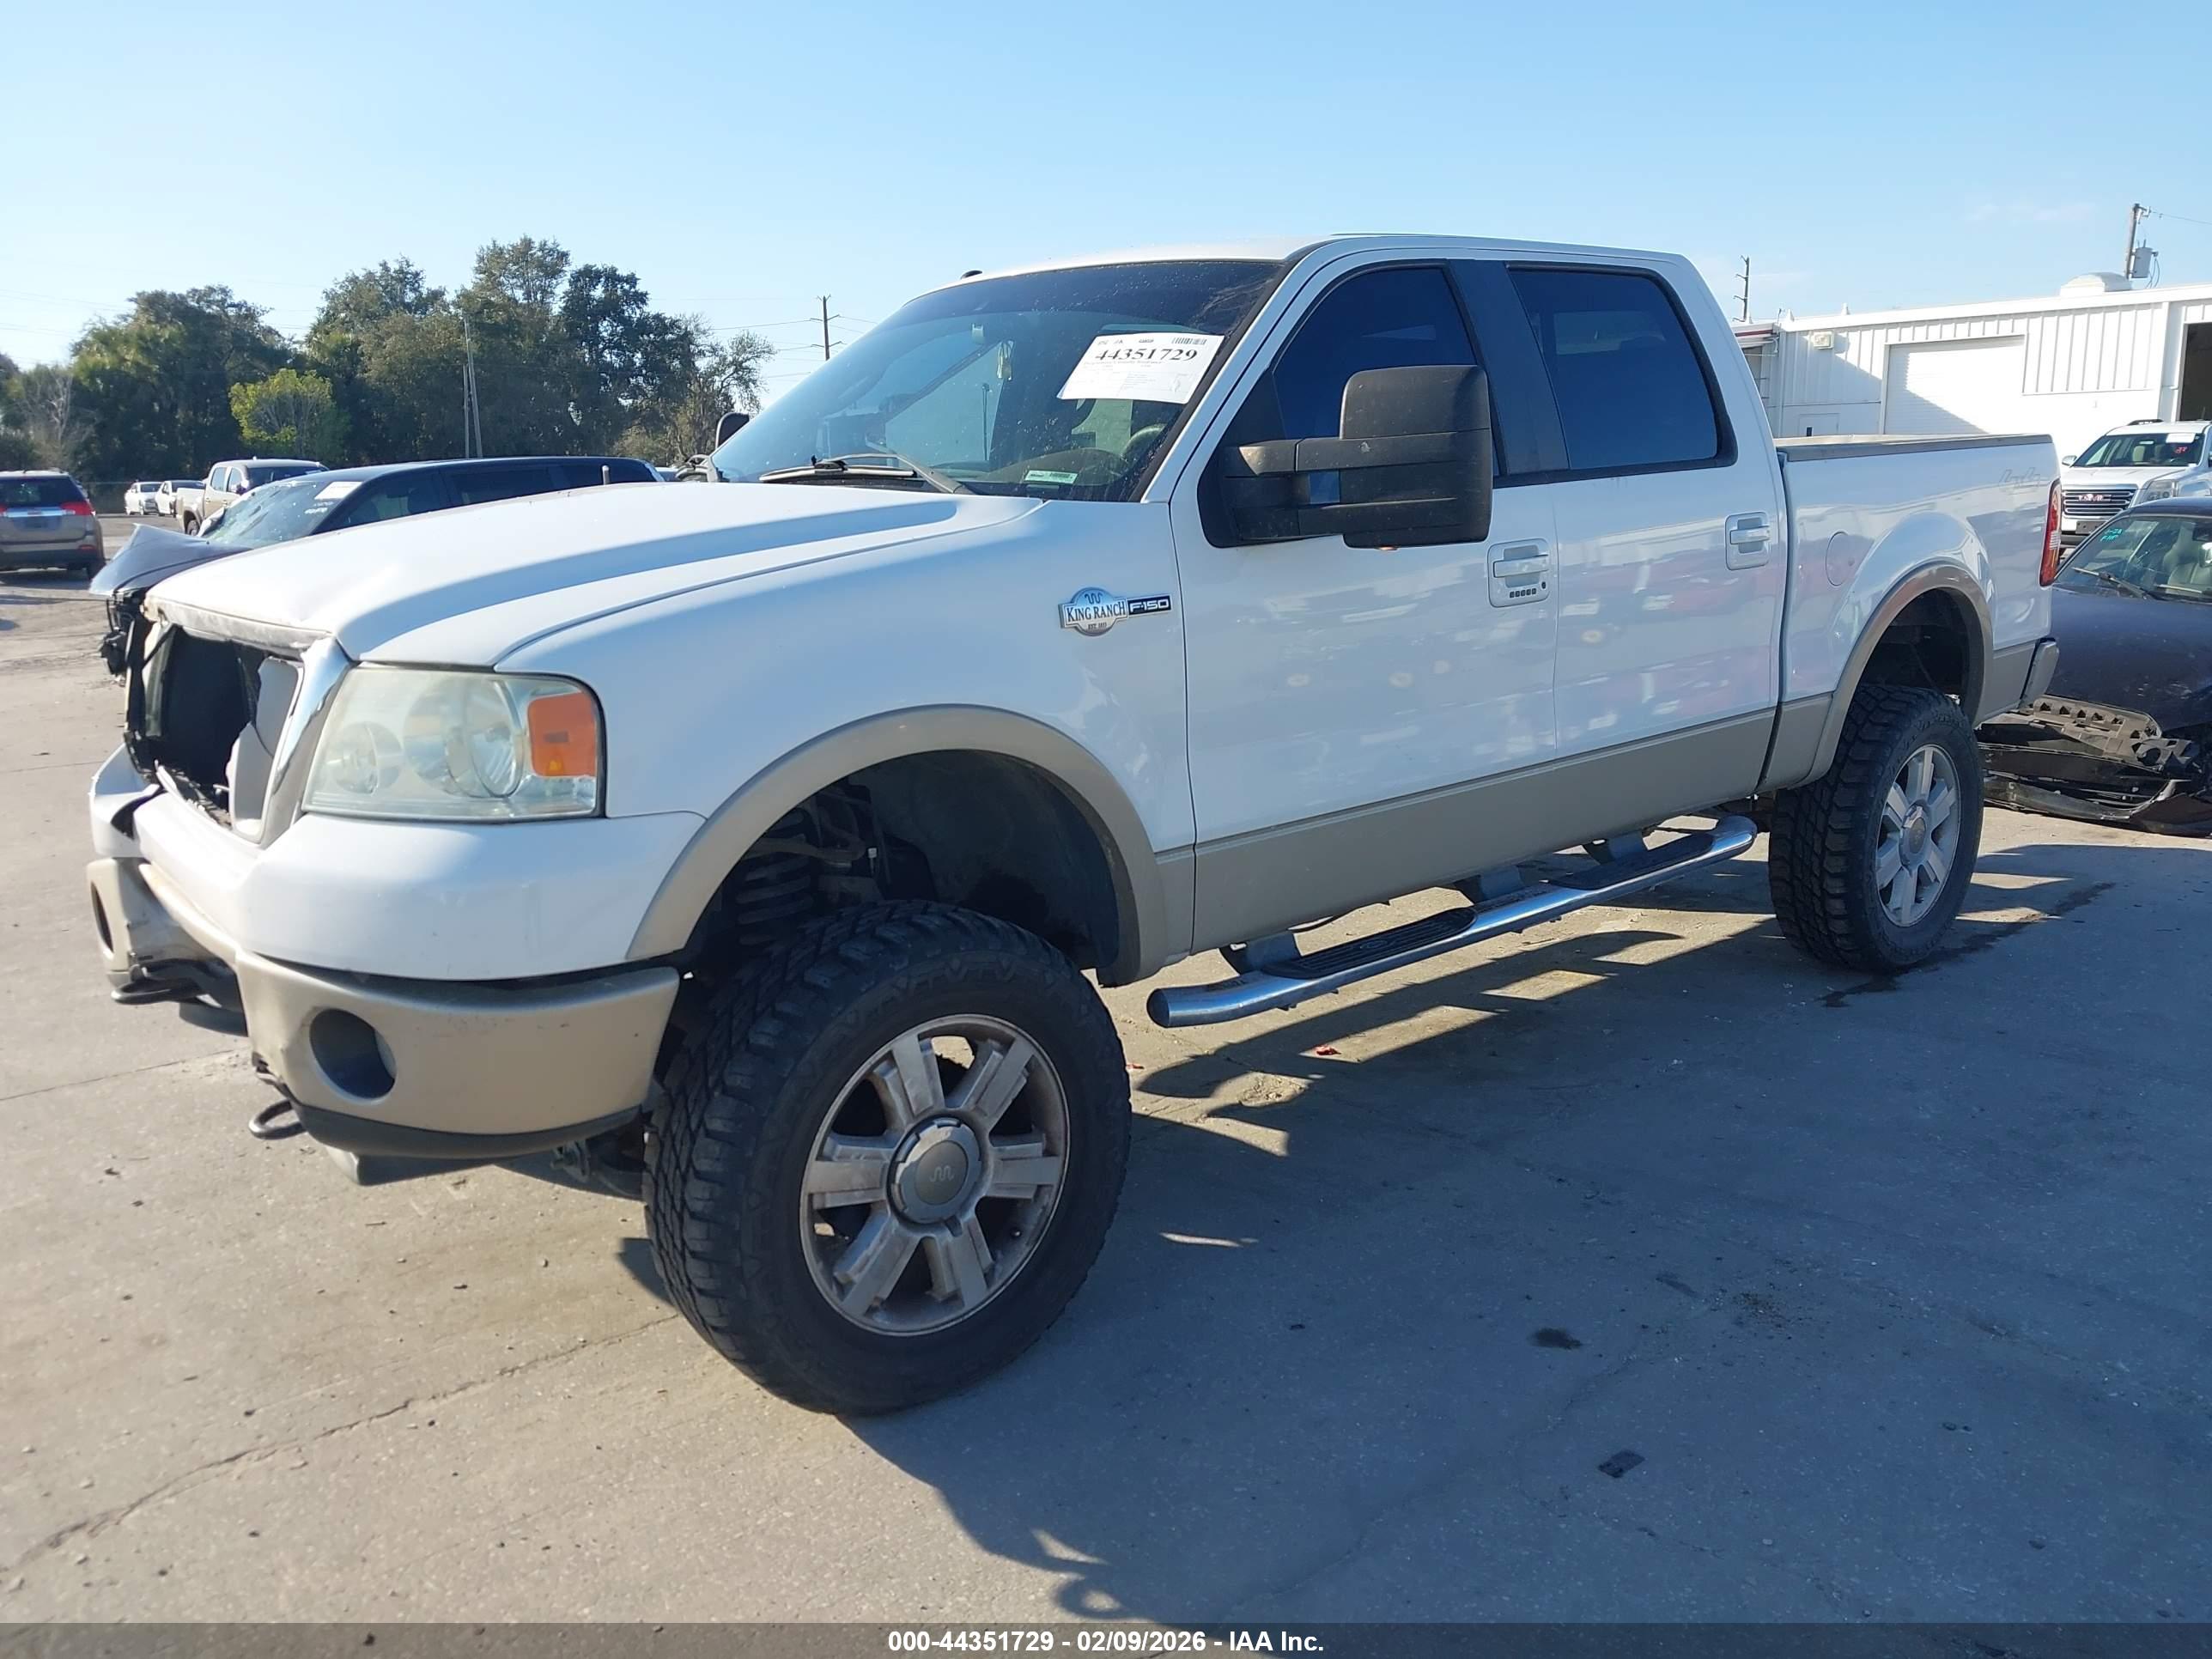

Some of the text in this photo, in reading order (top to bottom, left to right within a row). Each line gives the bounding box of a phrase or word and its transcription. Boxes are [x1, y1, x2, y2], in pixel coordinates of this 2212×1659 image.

[1095, 348, 1198, 362] 44351729
[1066, 601, 1127, 623] KING RANCH
